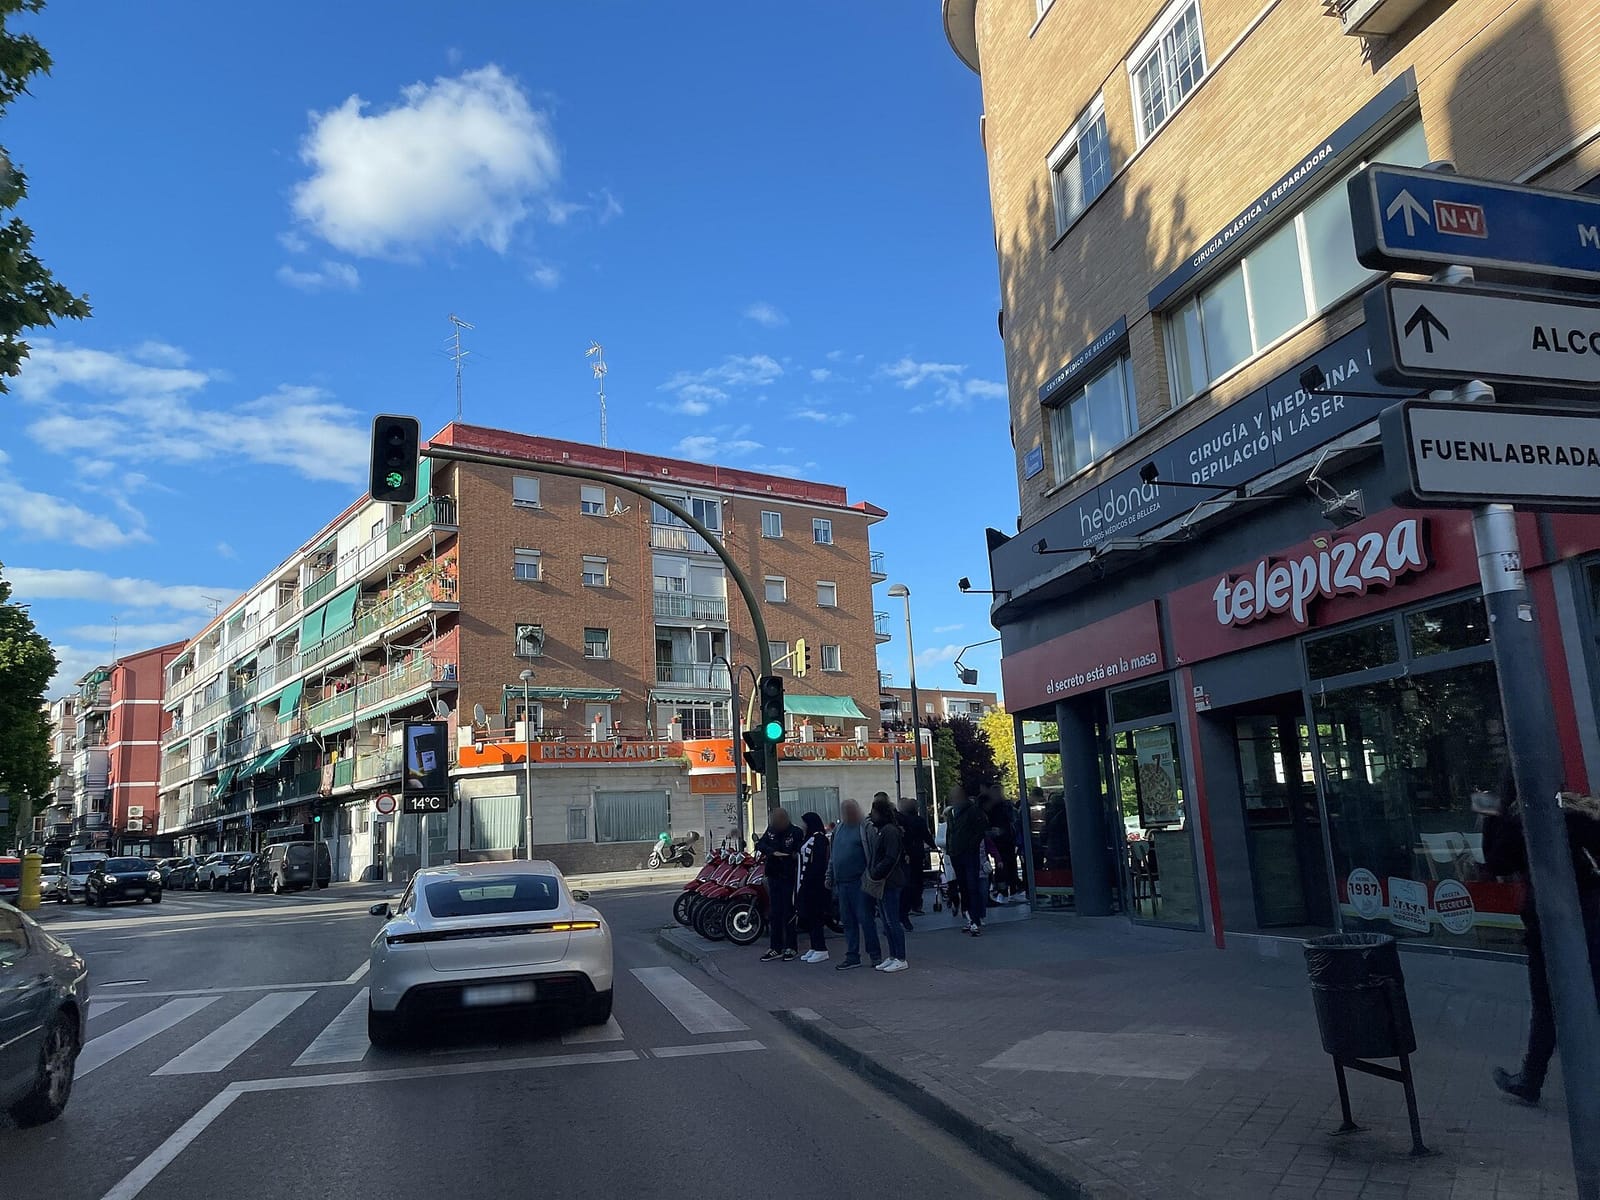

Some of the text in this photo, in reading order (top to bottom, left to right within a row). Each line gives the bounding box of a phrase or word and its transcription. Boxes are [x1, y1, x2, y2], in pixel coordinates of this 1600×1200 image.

[1192, 144, 1334, 267] CIRUGÍA PLÁSTICA Y REPARADORA
[1439, 208, 1482, 231] N-V
[1046, 372, 1065, 392] CENTRO
[1085, 350, 1092, 359] DE
[1093, 329, 1117, 353] BELLEZA
[1188, 358, 1360, 466] CIRUGÍA Y MEDINA
[1190, 395, 1346, 485] DEPILACIÓN LÁSER
[1420, 438, 1600, 468] FUENLABRADA
[1082, 531, 1105, 547] CENTROS
[1128, 514, 1136, 525] DE
[1136, 502, 1161, 520] BELLEZA
[1213, 520, 1424, 625] telepizza
[1047, 651, 1157, 694] el secreto está en la masa
[540, 744, 670, 759] RESTAURANTE
[783, 744, 827, 758] CHINO
[1349, 883, 1378, 896] 1987
[1439, 899, 1470, 911] SECRETA
